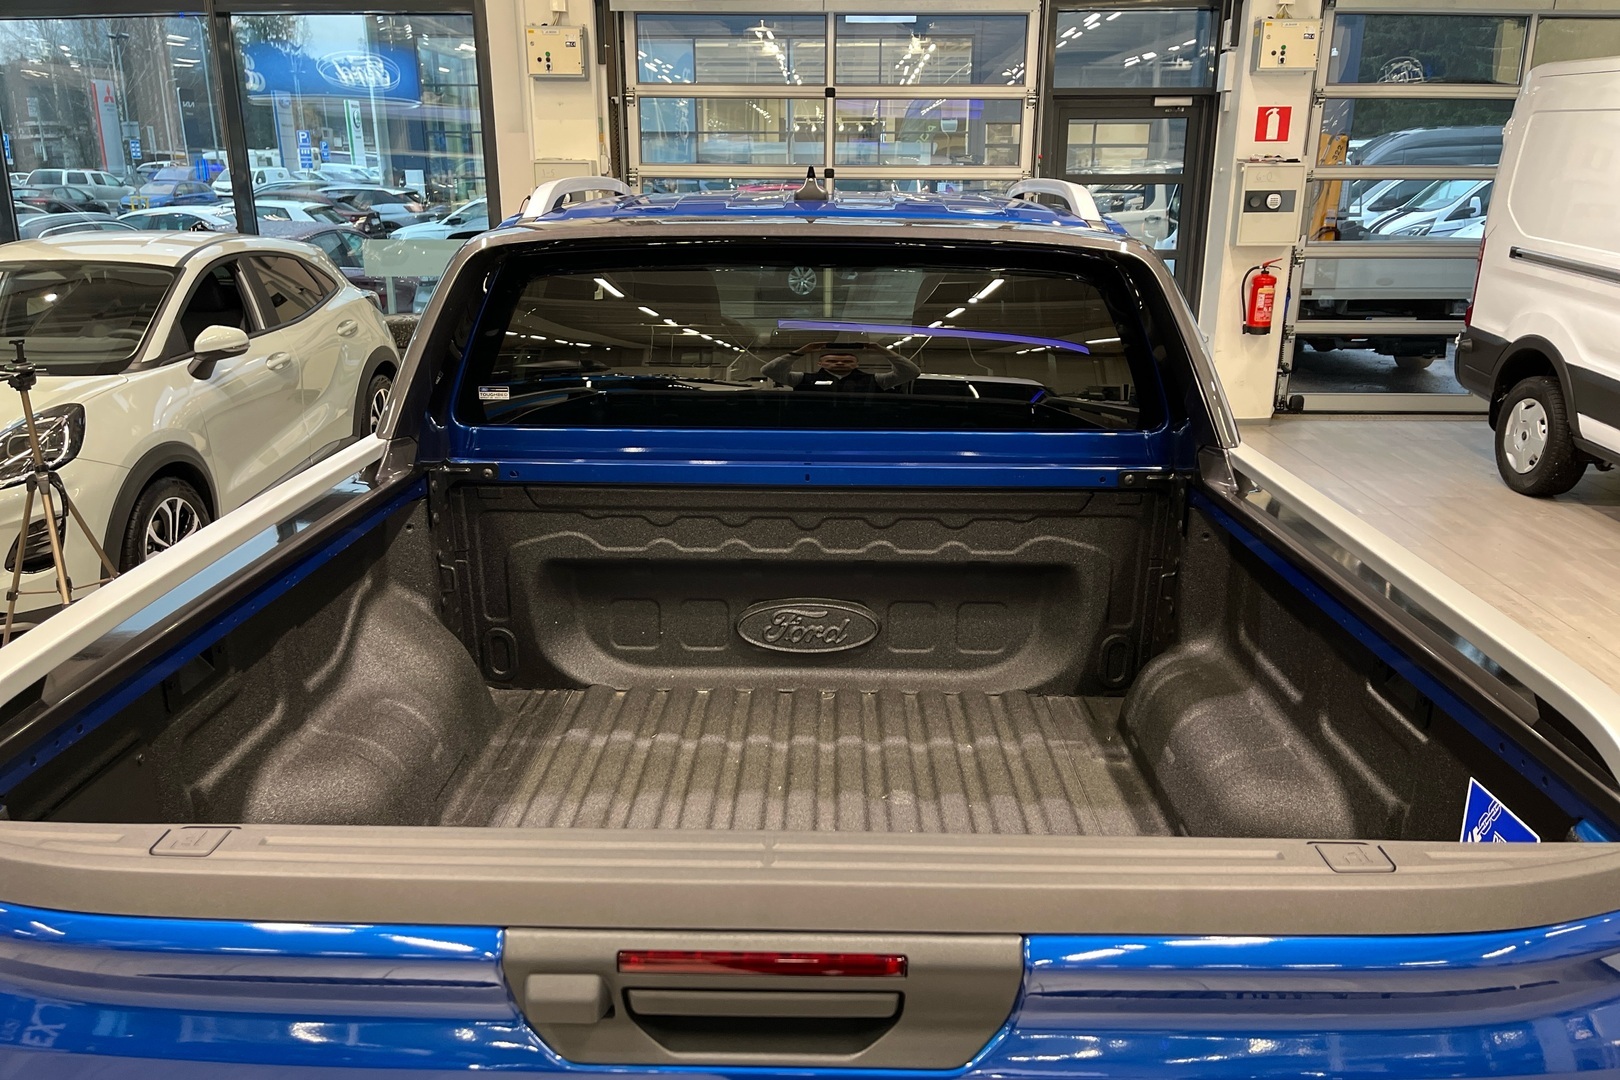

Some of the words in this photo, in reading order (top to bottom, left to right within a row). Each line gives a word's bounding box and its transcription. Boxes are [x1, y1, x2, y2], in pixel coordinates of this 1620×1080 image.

[299, 131, 307, 143] P
[321, 141, 327, 149] P
[761, 608, 851, 644] Ford
